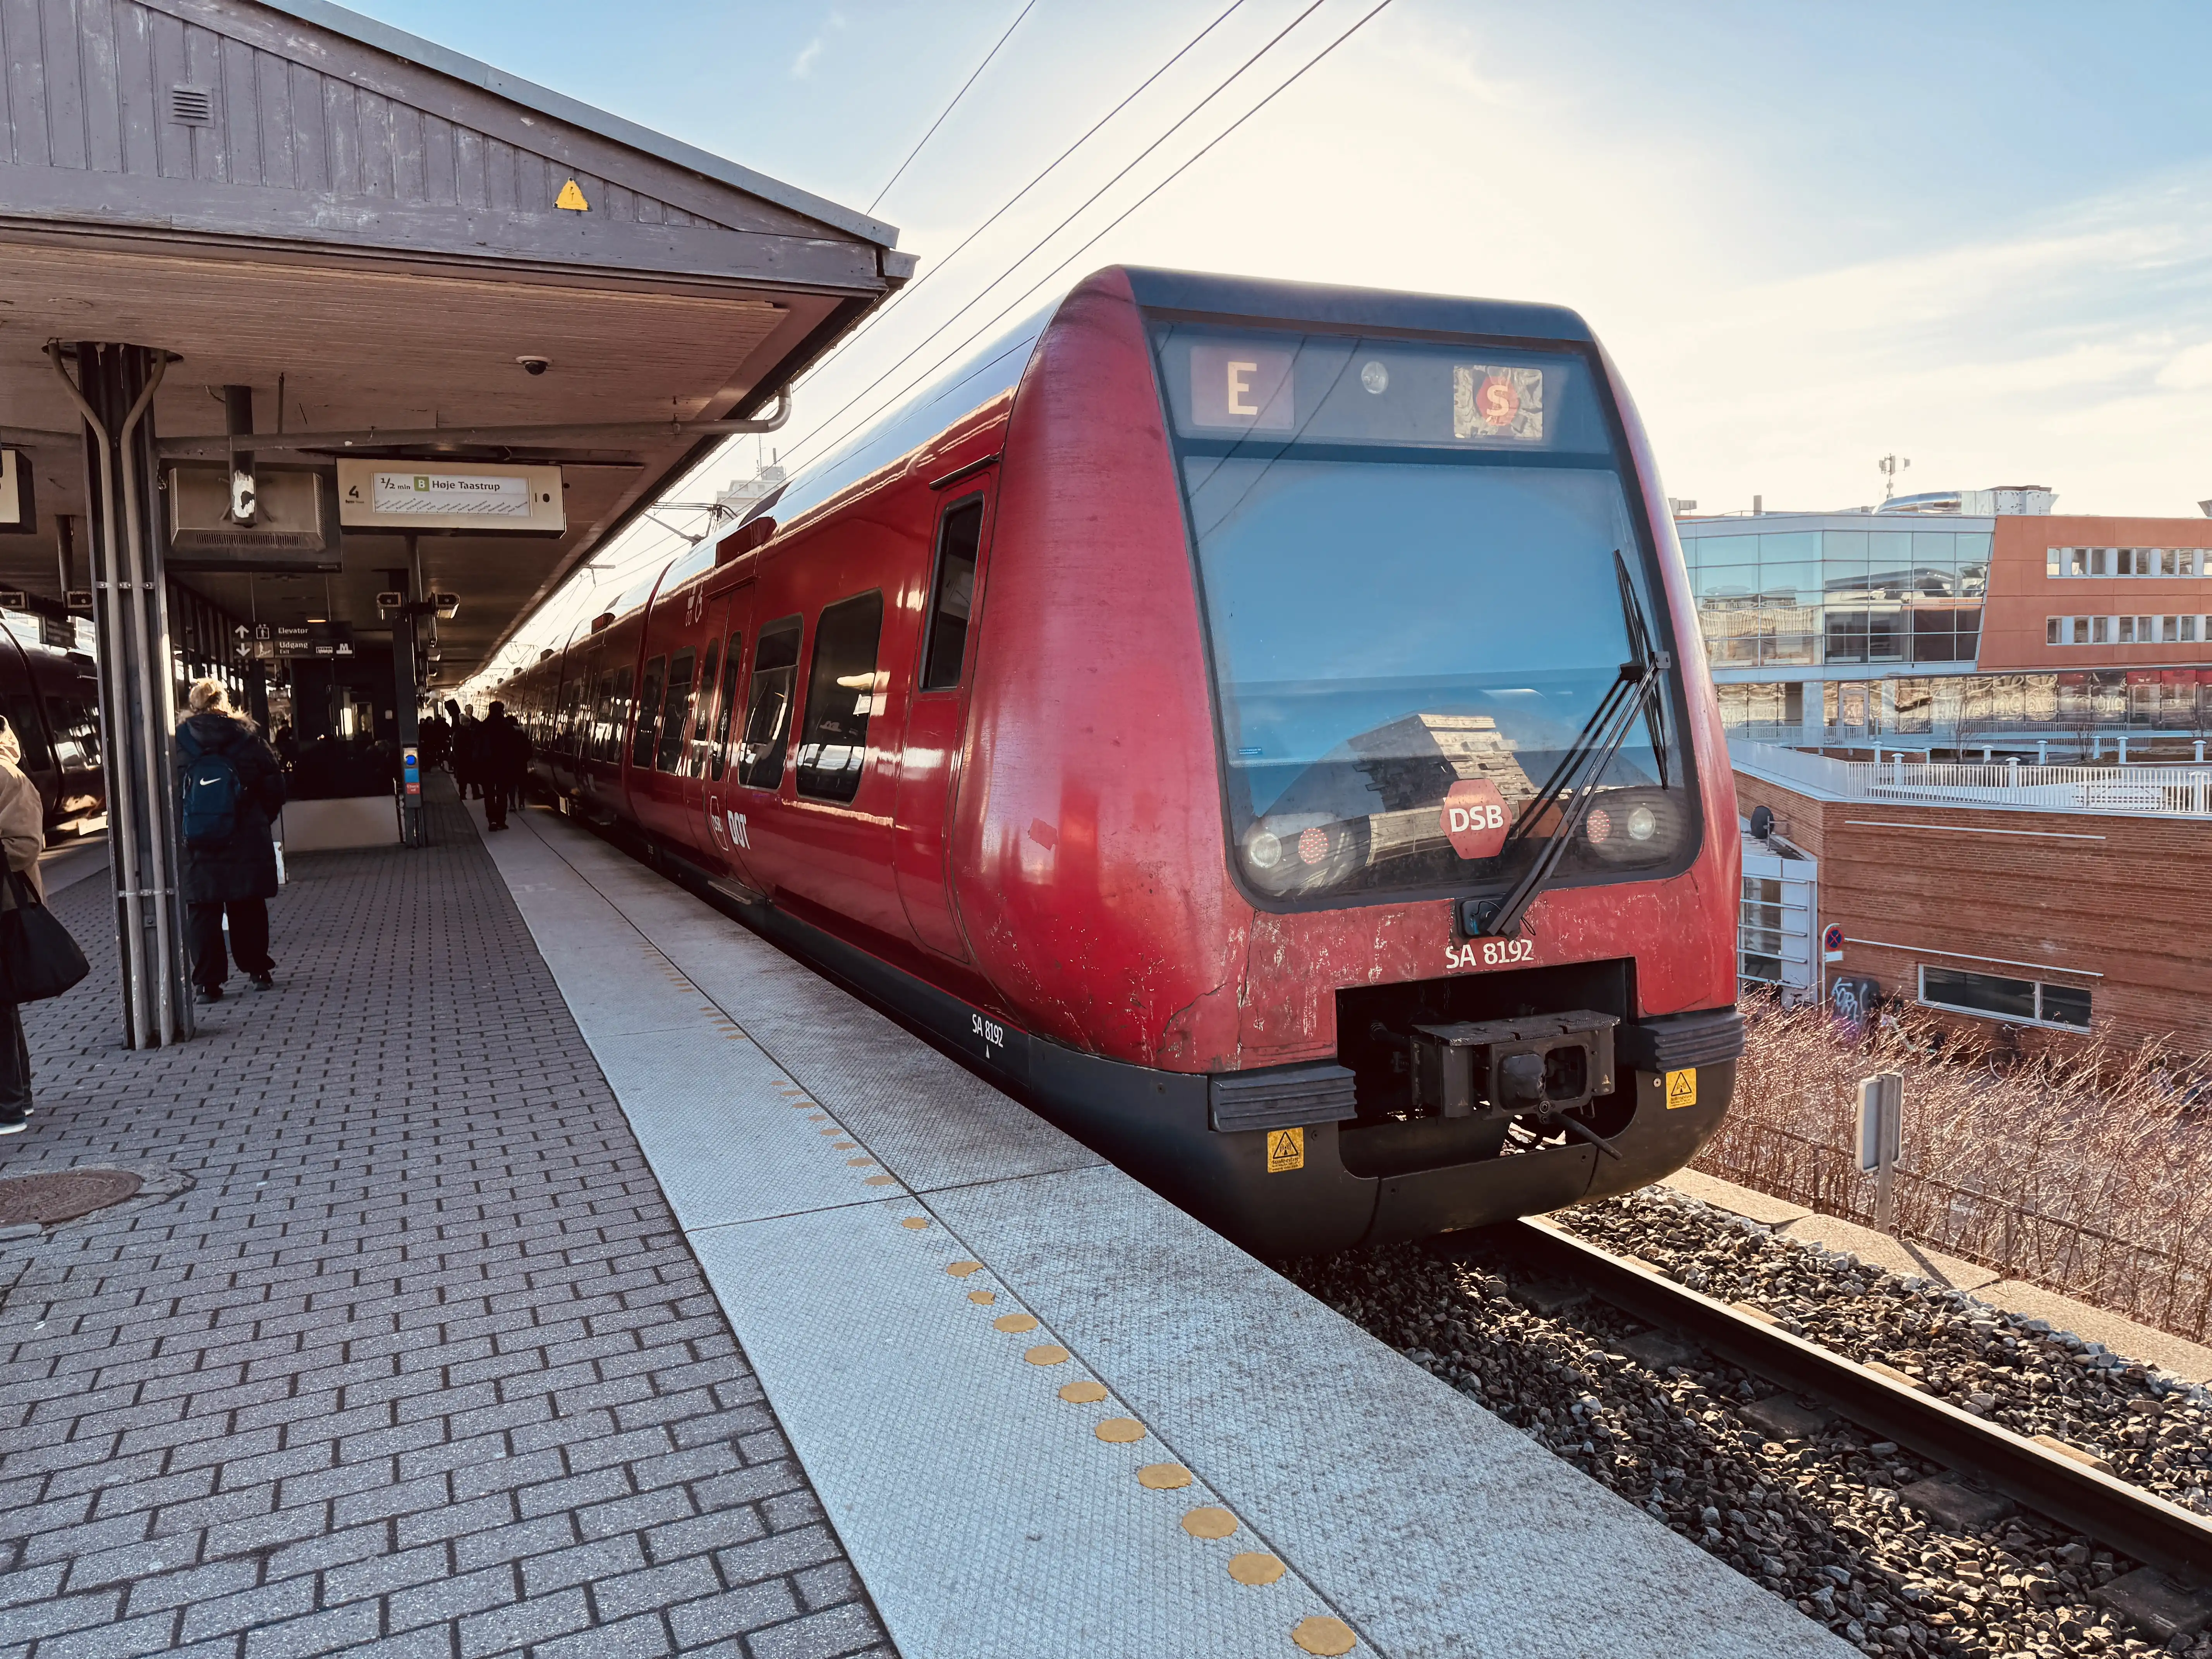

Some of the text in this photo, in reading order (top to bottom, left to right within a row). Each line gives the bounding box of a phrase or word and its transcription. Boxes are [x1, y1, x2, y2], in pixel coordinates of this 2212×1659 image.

[1228, 361, 1258, 415] E
[1486, 385, 1509, 416] S
[349, 486, 359, 498] 4
[418, 479, 425, 488] B
[432, 481, 500, 491] Høje Taastrup
[712, 814, 722, 832] DSB
[1449, 805, 1504, 832] DSB
[1445, 939, 1534, 969] SA 8192
[972, 1013, 1003, 1048] SA 8192
